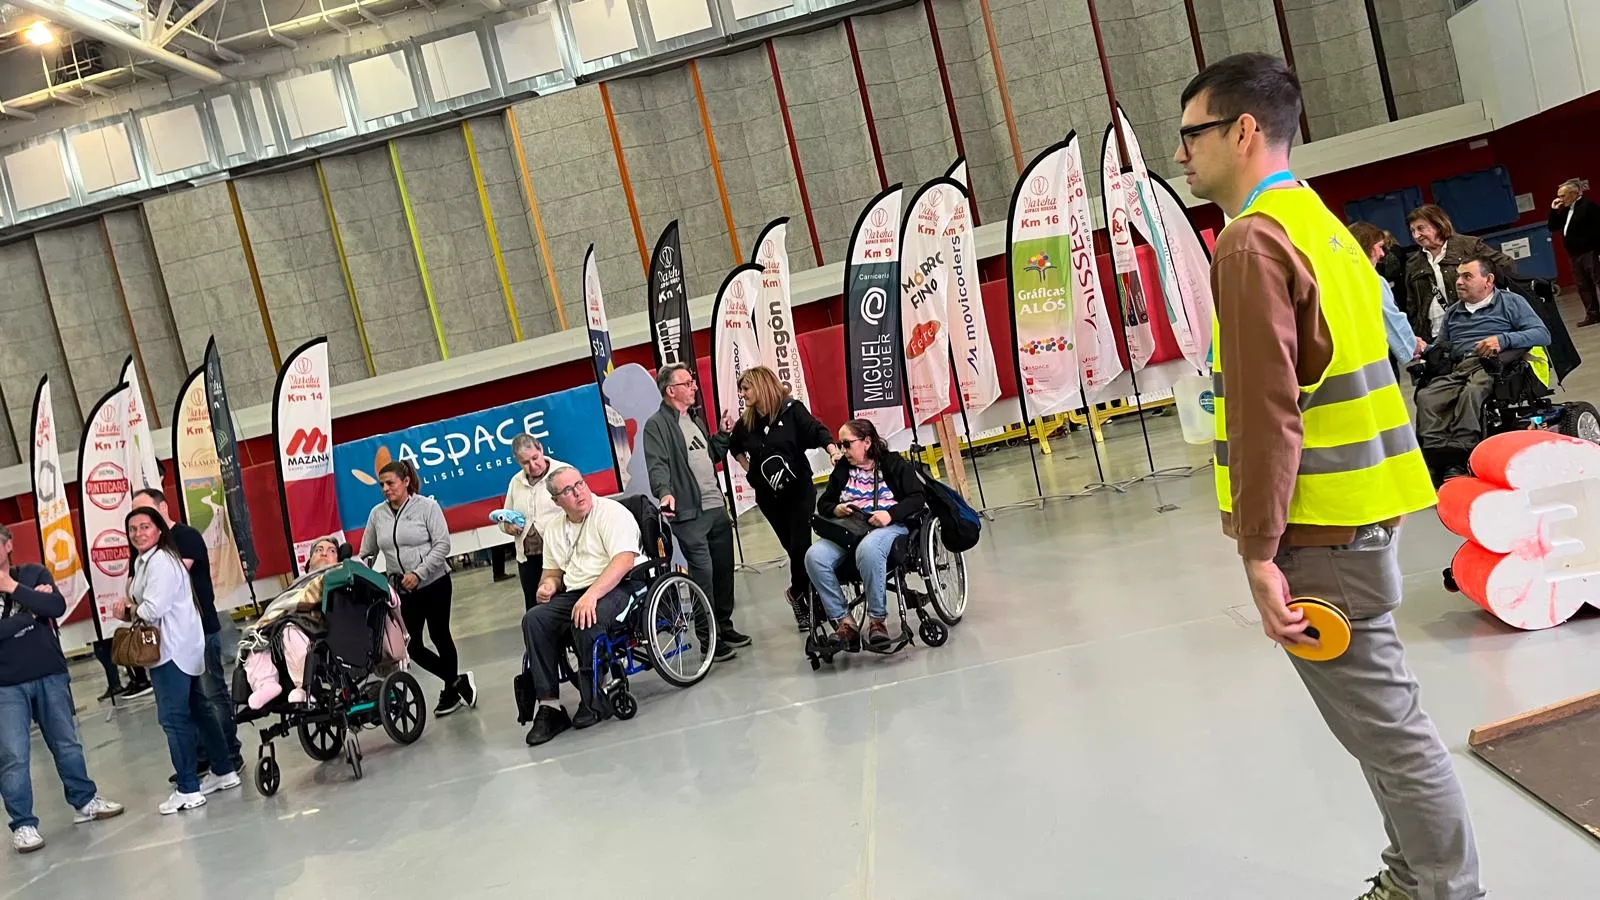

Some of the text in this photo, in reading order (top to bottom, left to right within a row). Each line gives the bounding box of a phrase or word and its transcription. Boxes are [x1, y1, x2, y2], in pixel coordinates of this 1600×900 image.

[1021, 214, 1059, 229] Km 16
[917, 224, 936, 236] Km
[864, 247, 893, 259] Km 9
[762, 278, 778, 289] Km
[952, 235, 976, 340] movicoders
[911, 278, 938, 310] FINO
[1018, 286, 1066, 301] Gráficas
[1020, 298, 1066, 316] ALÓS
[725, 319, 741, 329] Km
[861, 334, 884, 402] MIGUEL
[881, 333, 894, 400] ESCUER
[287, 391, 323, 403] Km 14
[186, 426, 204, 436] Km
[398, 410, 550, 470] ASPACE
